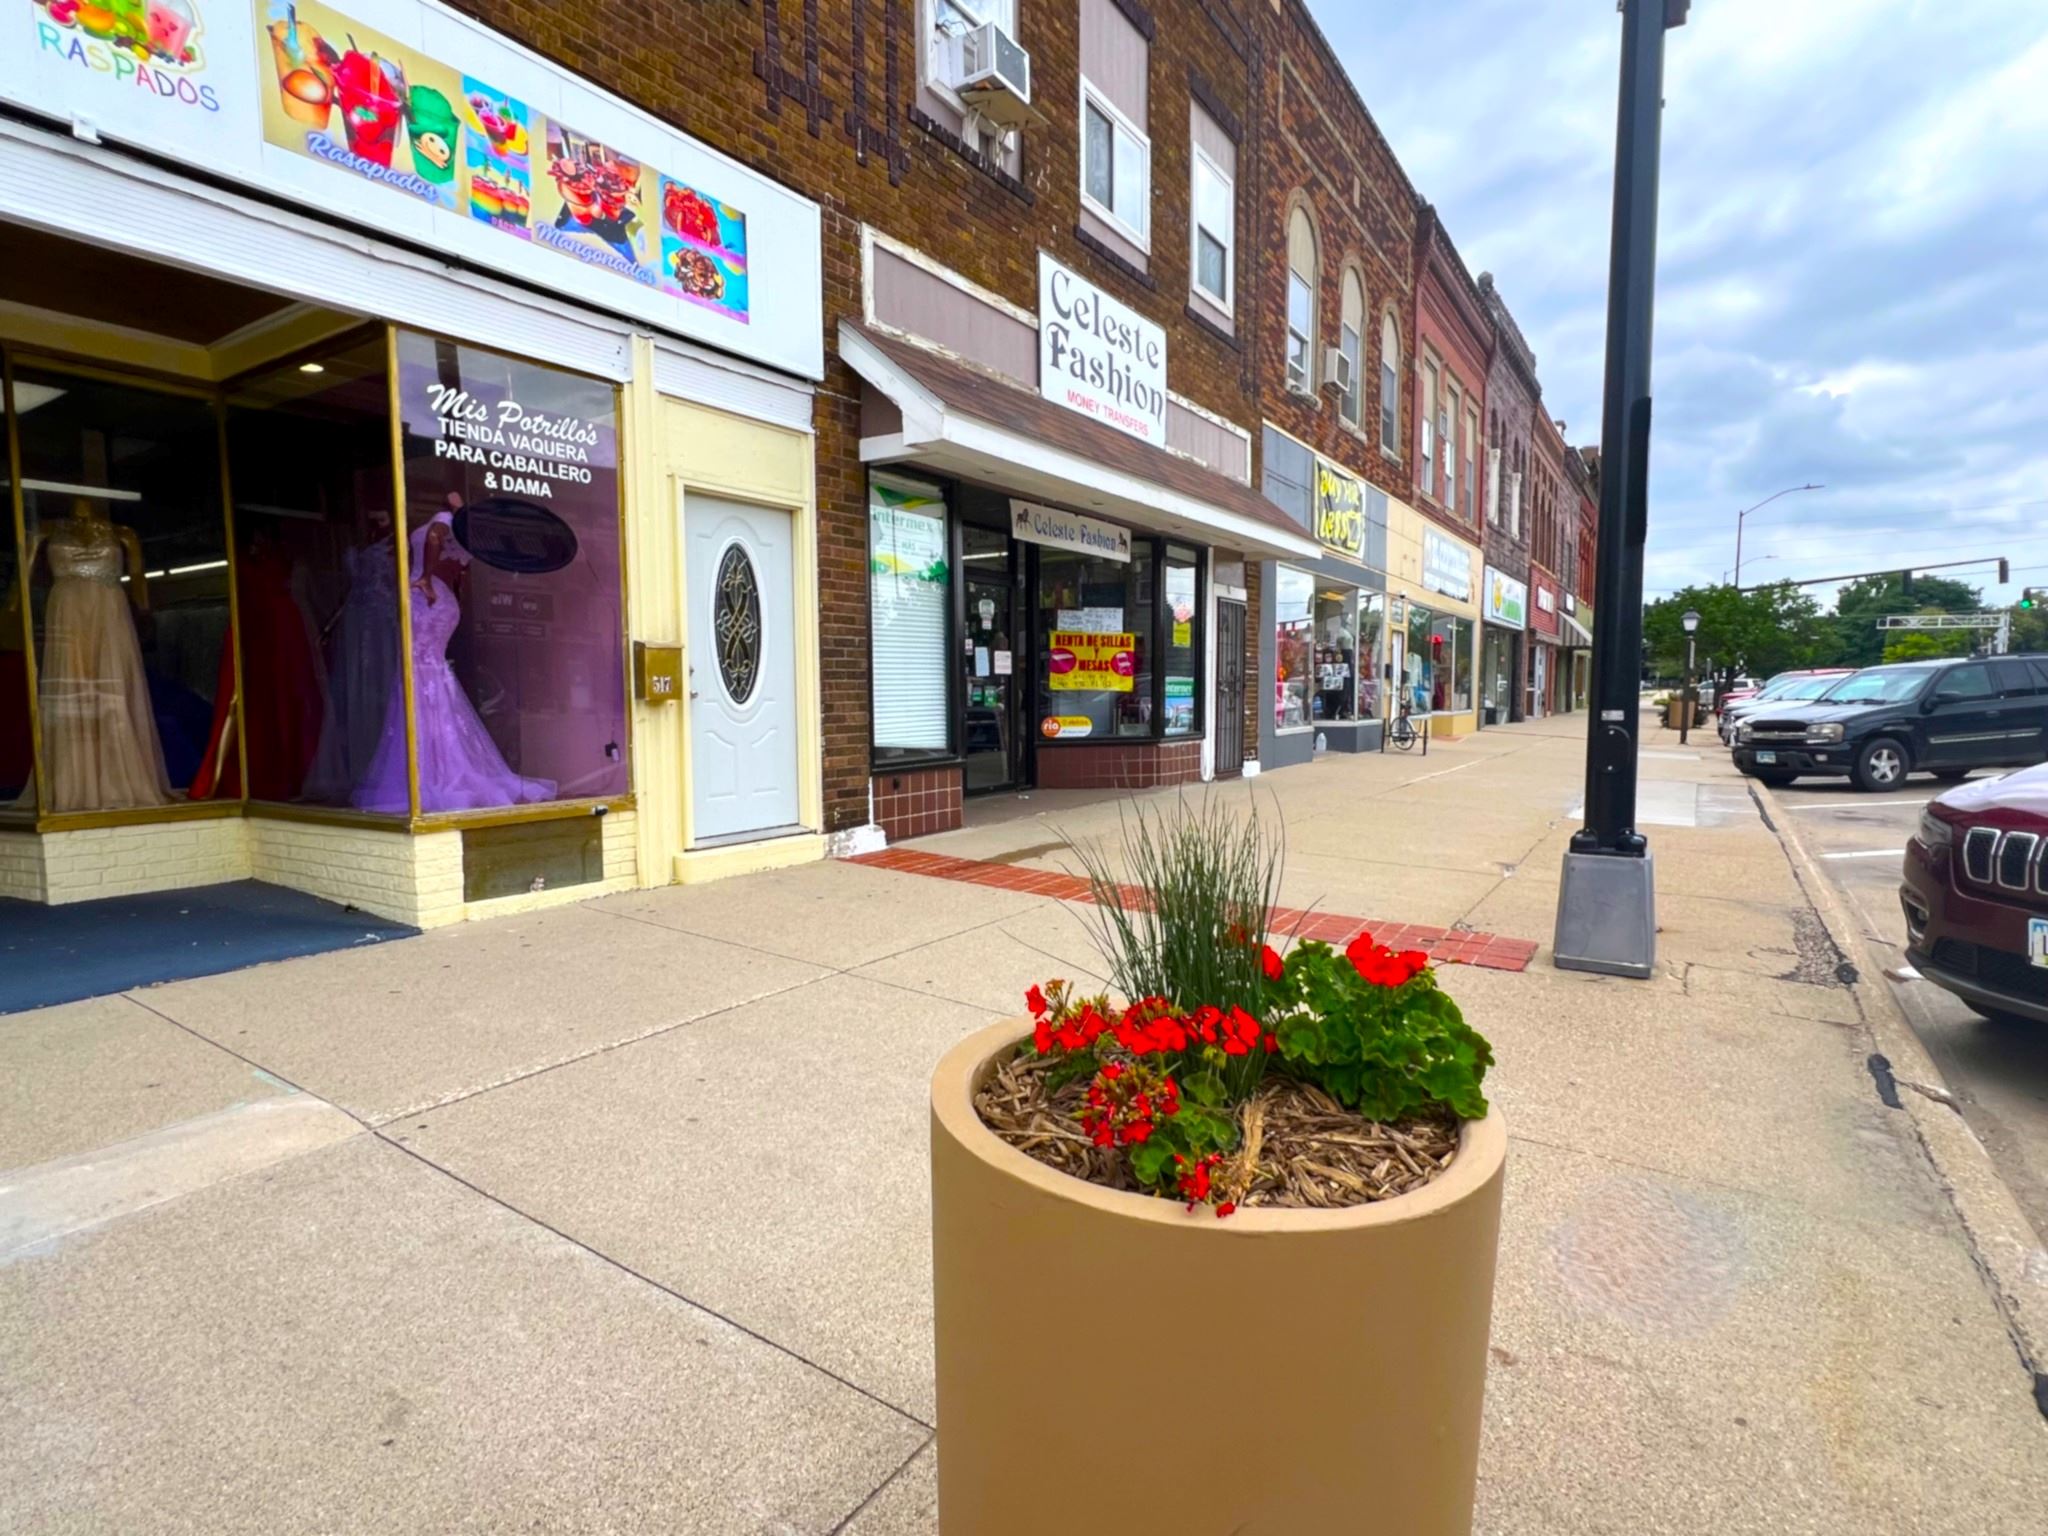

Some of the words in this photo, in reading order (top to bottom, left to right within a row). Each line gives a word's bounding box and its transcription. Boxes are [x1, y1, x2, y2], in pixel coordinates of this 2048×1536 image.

[37, 22, 220, 113] RASPADOS
[1051, 270, 1159, 369] Celeste
[1046, 322, 1163, 426] Fashion
[427, 384, 488, 421] Mis
[497, 401, 599, 446] Potrillo's
[1067, 389, 1100, 414] MONEY
[1103, 405, 1149, 437] TRANSFERS
[434, 440, 486, 466] PARA
[490, 452, 592, 484] CABALLERO
[437, 417, 504, 446] TIENDA
[508, 432, 588, 463] VAQUERA
[484, 471, 498, 490] &
[502, 474, 552, 498] DAMA
[1033, 513, 1075, 541] Celeste
[1080, 523, 1116, 552] Fashion
[1055, 634, 1084, 647] RENTA
[1087, 634, 1099, 647] DE
[1101, 635, 1131, 648] SILLAS
[1094, 648, 1099, 660] Y
[652, 676, 671, 693] 517
[1079, 659, 1109, 672] MESAS
